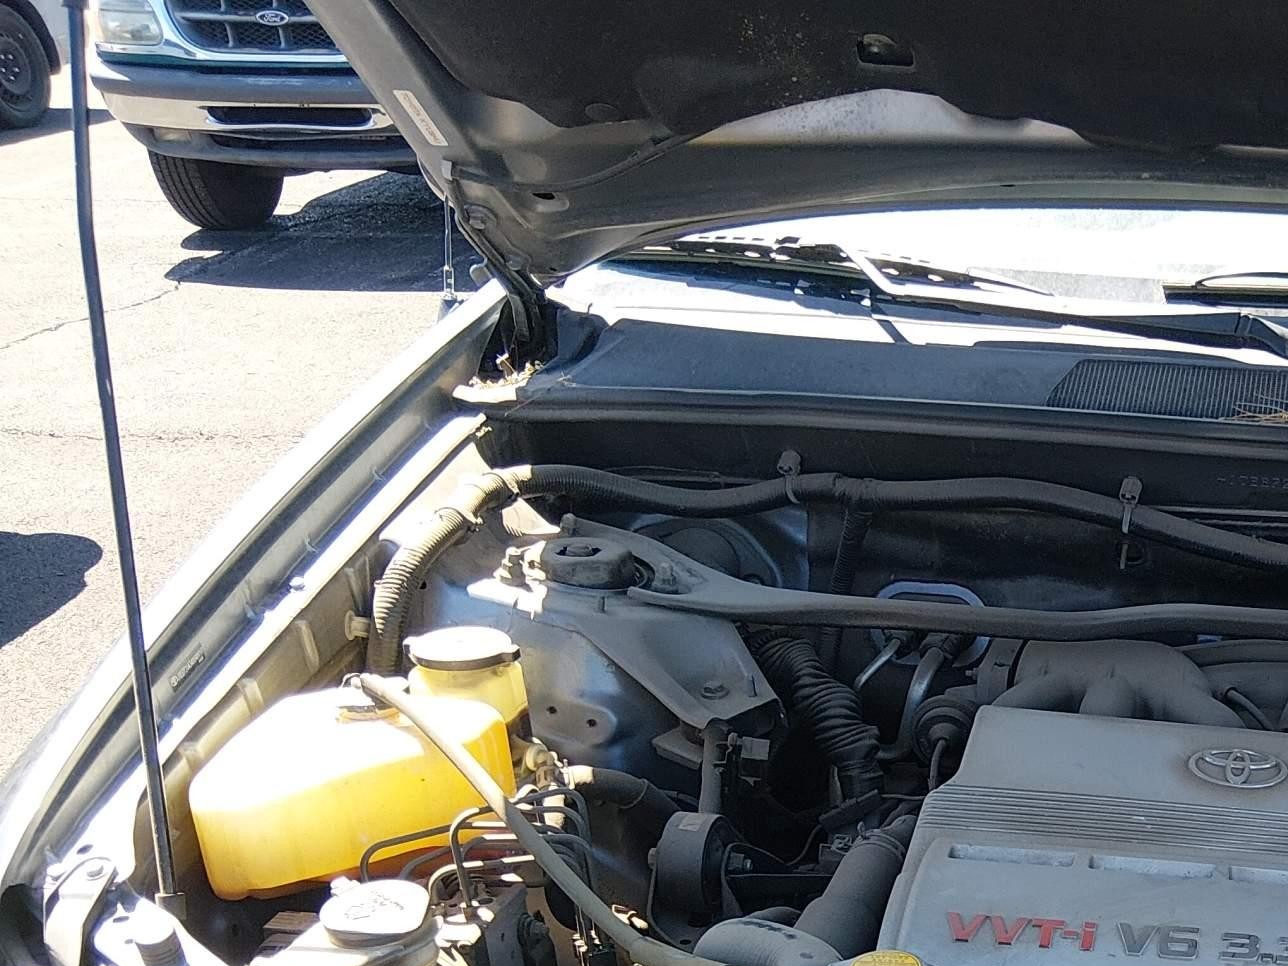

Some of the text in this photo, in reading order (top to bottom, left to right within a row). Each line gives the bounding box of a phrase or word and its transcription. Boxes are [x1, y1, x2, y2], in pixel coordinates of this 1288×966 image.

[263, 13, 281, 22] Ford
[947, 911, 1098, 951] VVT-i
[1116, 921, 1201, 960] V6
